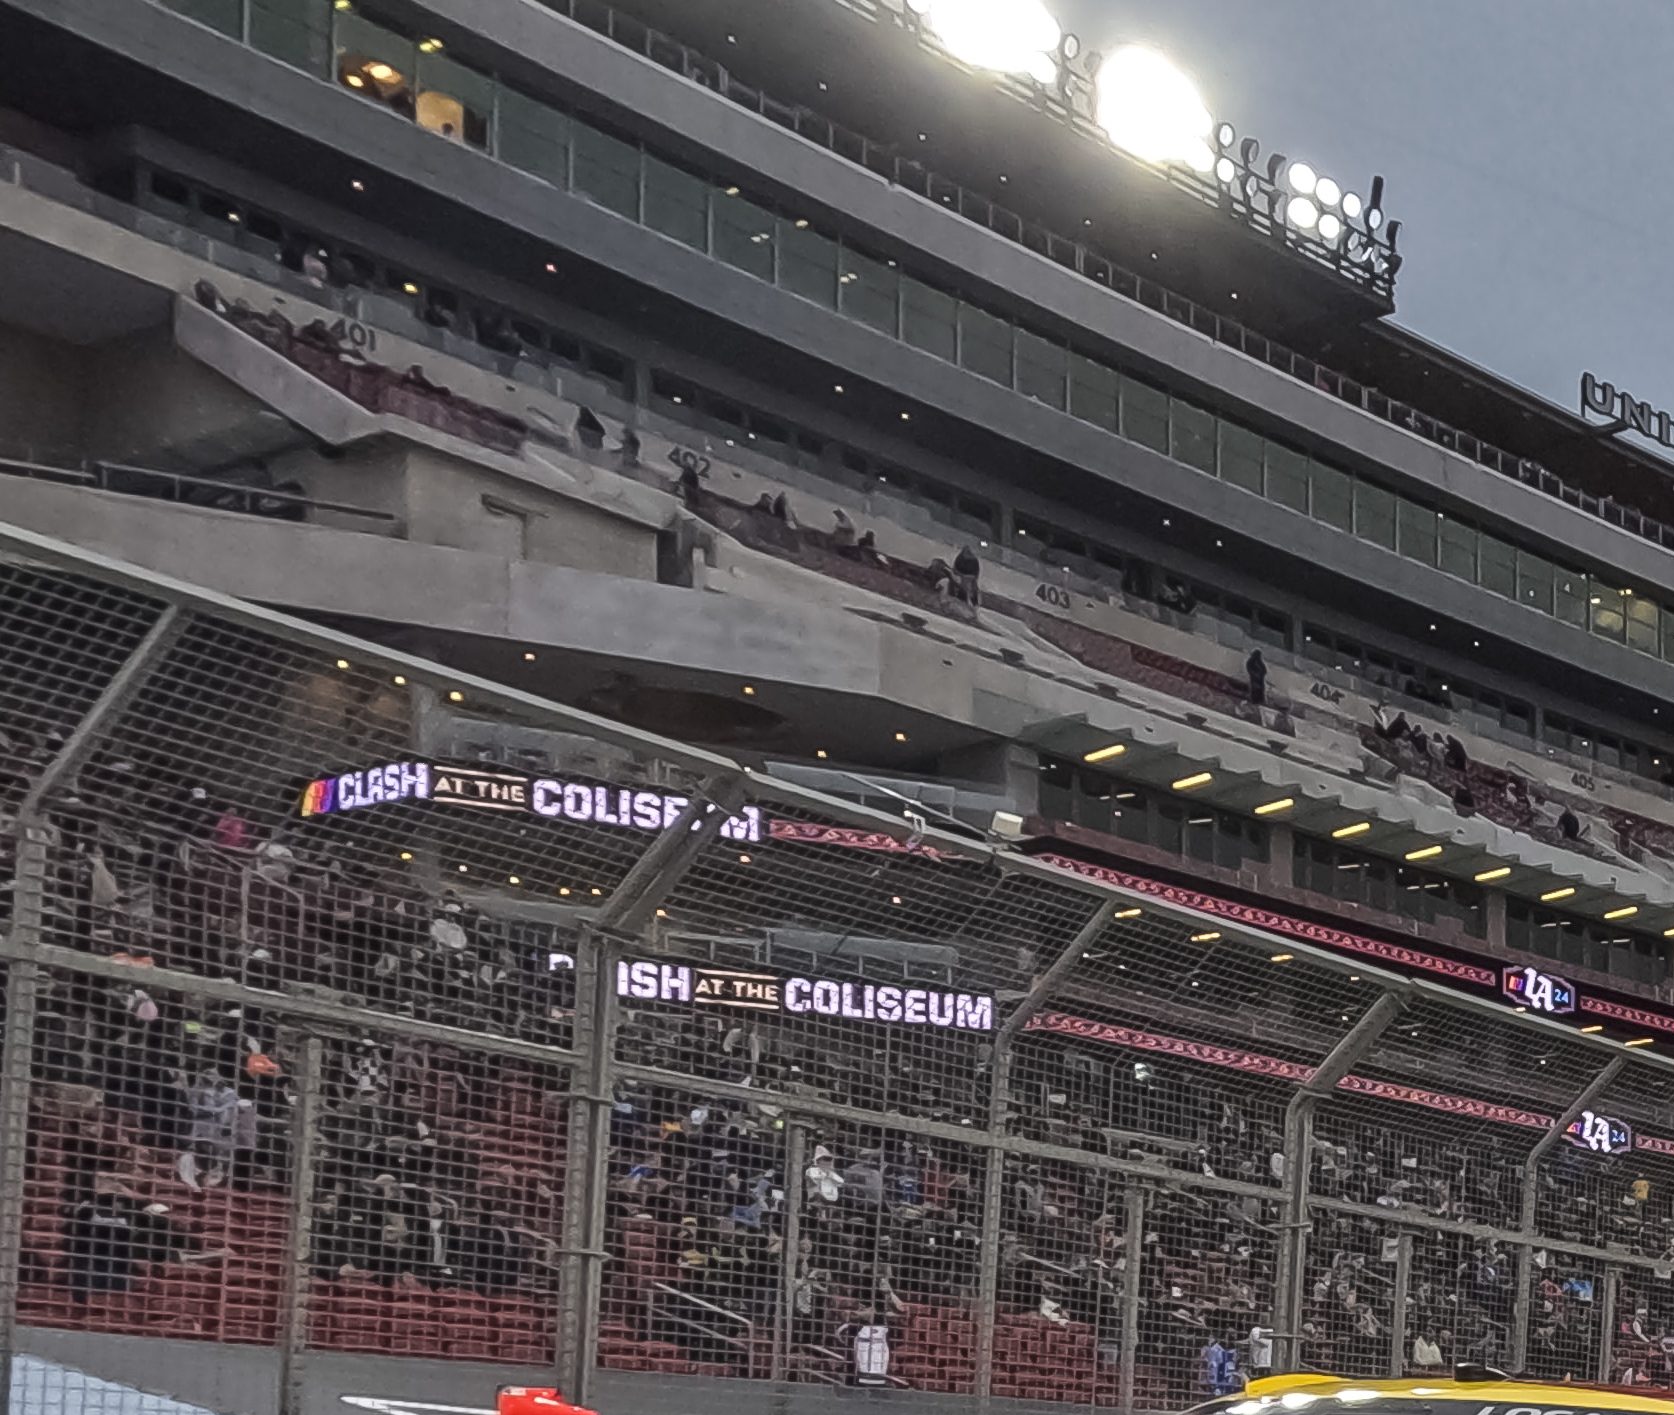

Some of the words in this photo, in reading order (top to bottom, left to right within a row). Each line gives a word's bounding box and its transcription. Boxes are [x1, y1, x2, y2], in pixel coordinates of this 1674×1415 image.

[668, 446, 711, 479] 402
[1035, 583, 1070, 610] 403
[339, 762, 429, 810] CLASH
[434, 776, 466, 793] AT
[475, 780, 526, 803] THE
[532, 778, 761, 841] COLISEM
[695, 980, 723, 995] AT
[733, 982, 780, 1002] THE
[785, 977, 992, 1029] COLISEUM
[1524, 967, 1554, 1011] LA
[1555, 989, 1569, 1003] 24
[1582, 1110, 1611, 1152] LA
